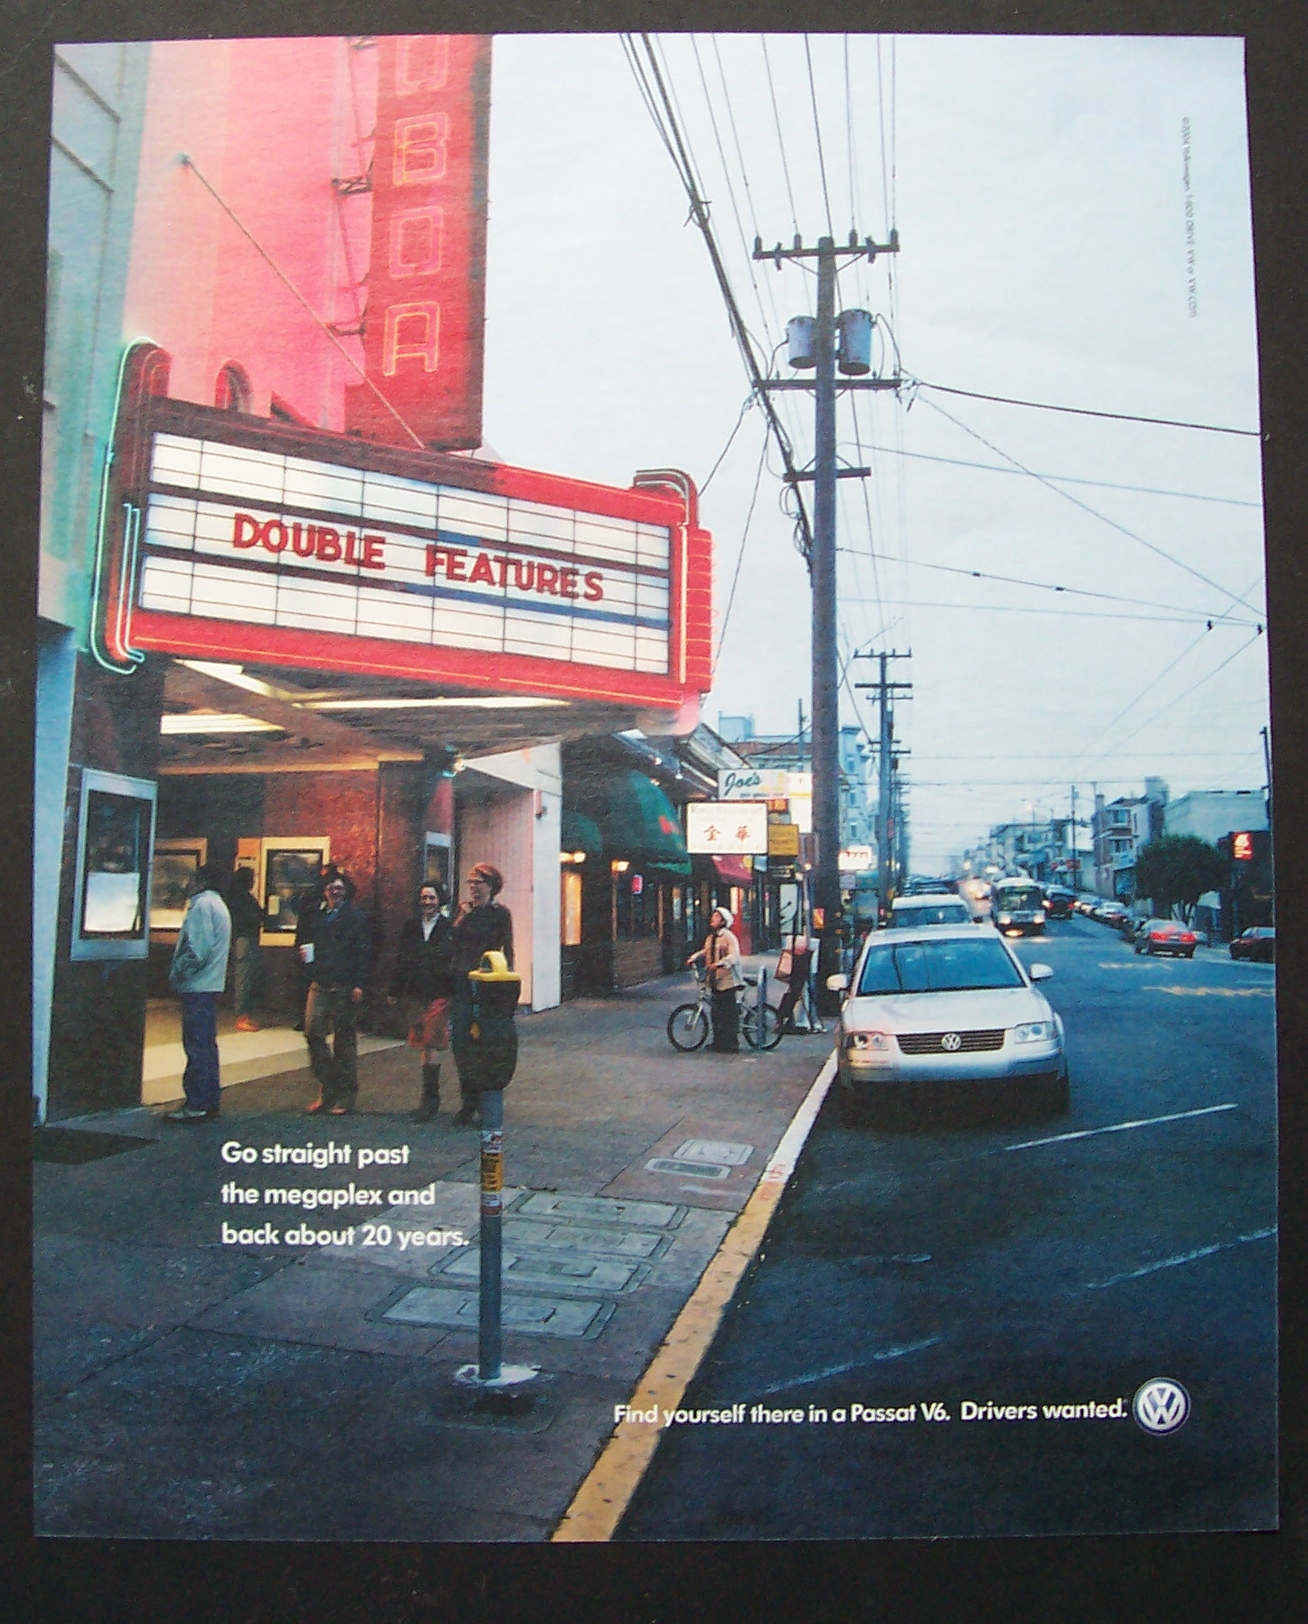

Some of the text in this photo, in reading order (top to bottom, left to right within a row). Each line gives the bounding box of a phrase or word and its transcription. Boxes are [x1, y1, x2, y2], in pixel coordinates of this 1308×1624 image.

[233, 514, 602, 600] DOUBLE FEATURES
[222, 1142, 410, 1168] Go straight past
[221, 1182, 436, 1209] the megaplex and
[223, 1222, 470, 1251] back about 20 years.
[613, 1397, 1129, 1427] Find yourself there in a Passat V6. Drivers wanted.
